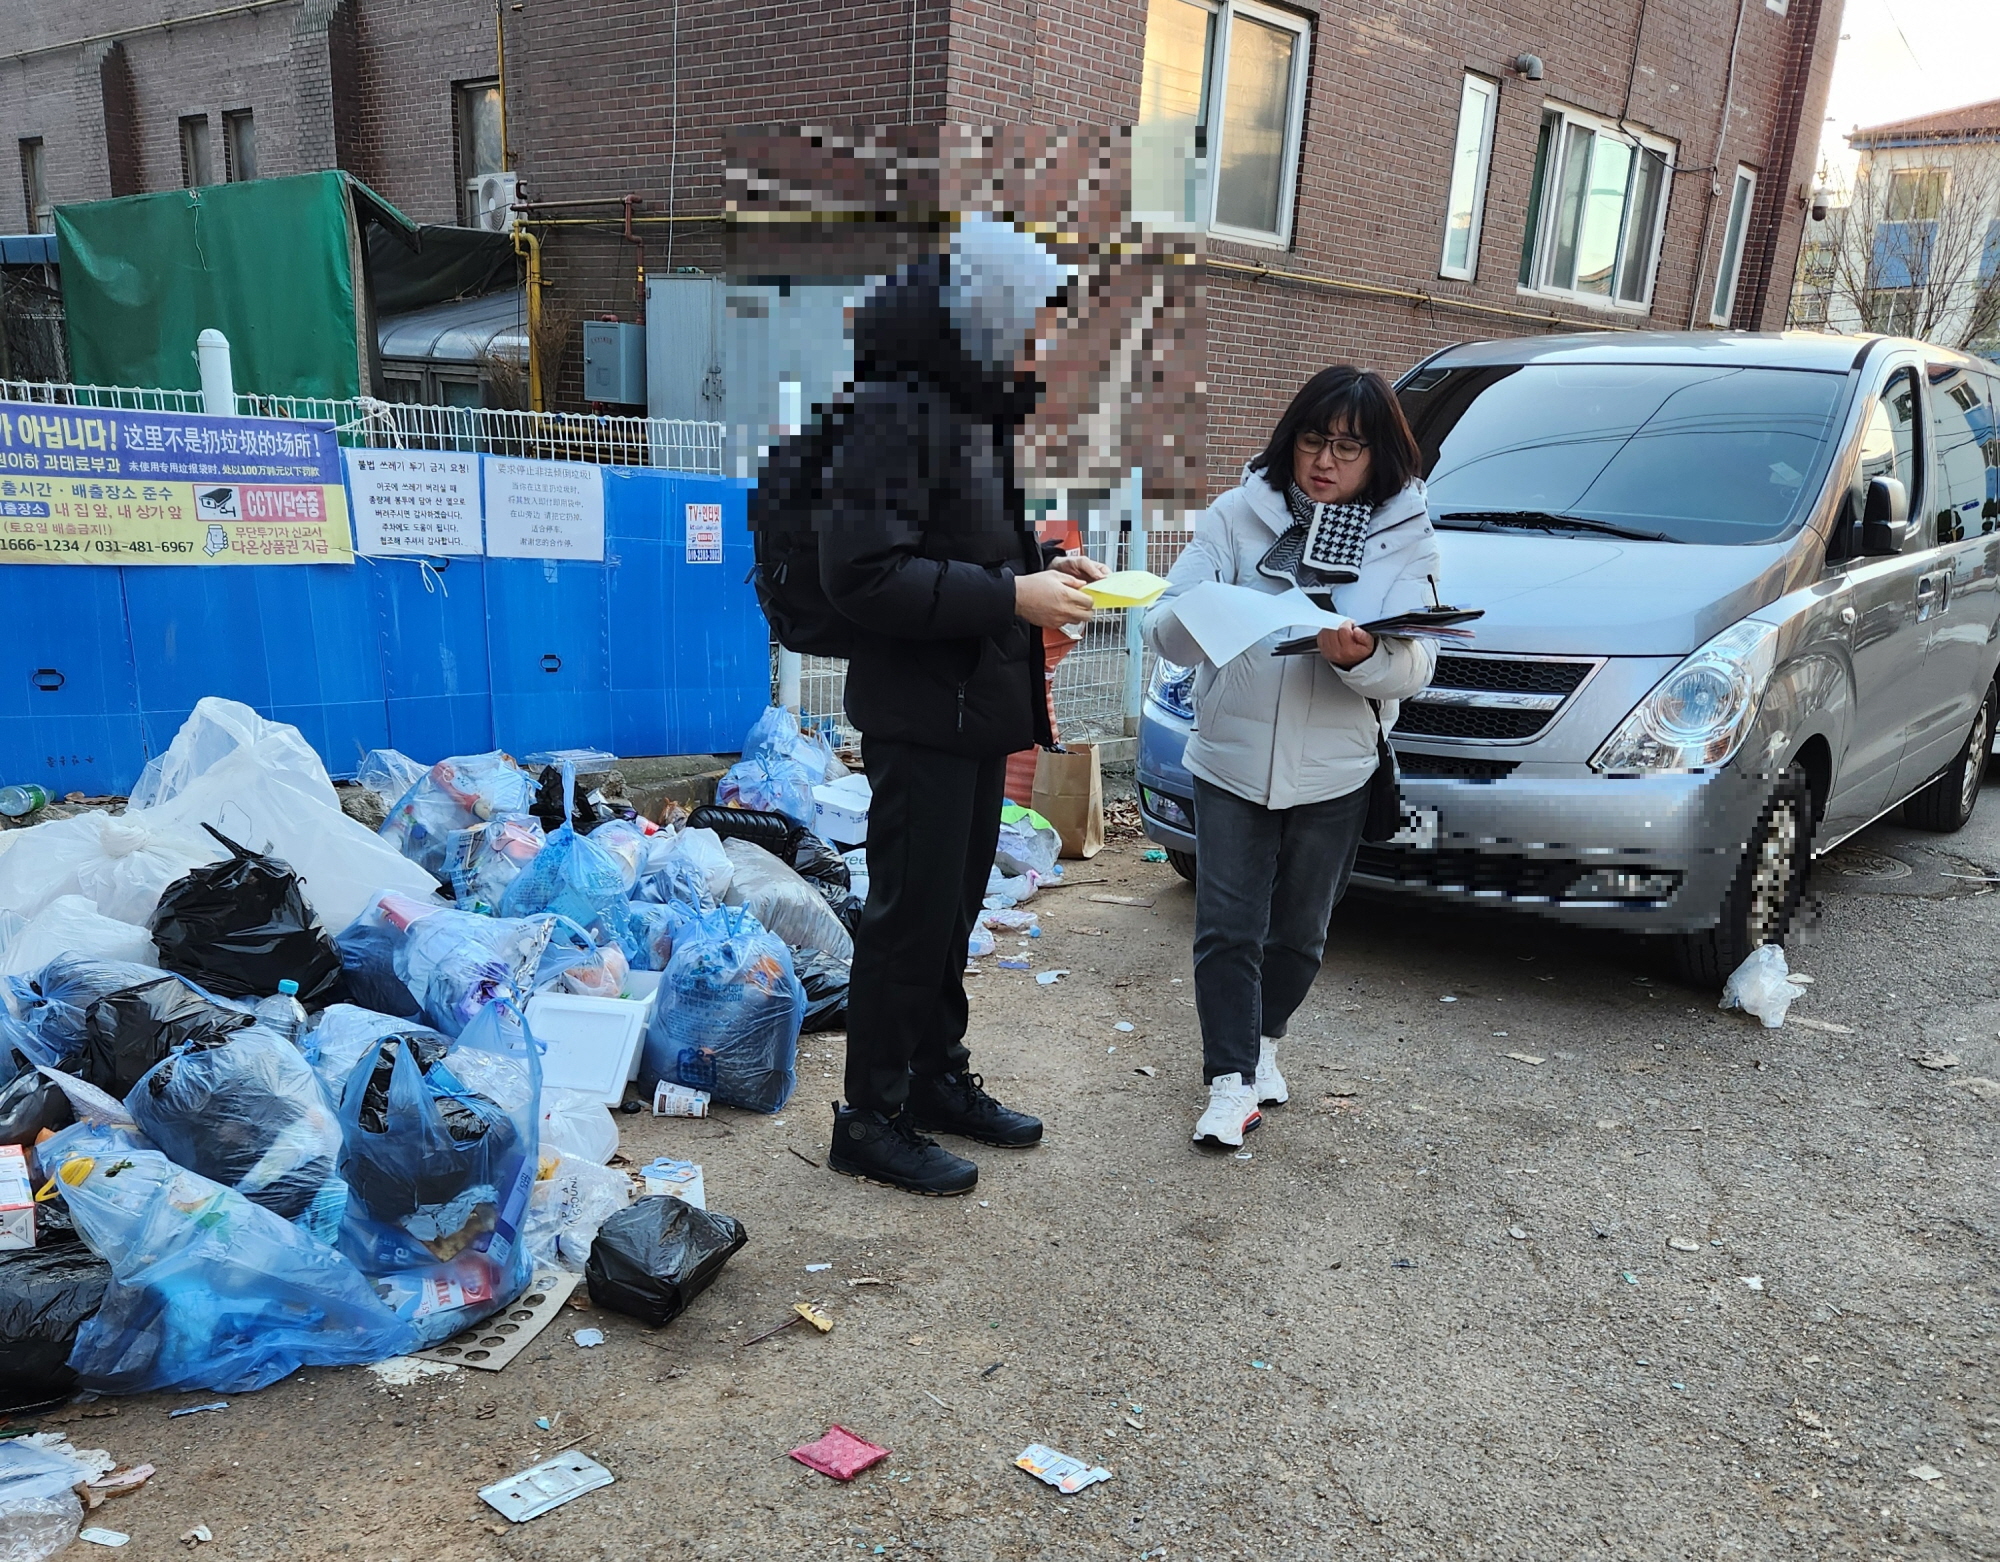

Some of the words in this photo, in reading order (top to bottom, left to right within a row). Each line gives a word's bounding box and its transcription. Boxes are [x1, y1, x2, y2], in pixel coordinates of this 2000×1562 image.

[18, 414, 117, 451] 아닙니다!
[123, 423, 321, 458] 这里不是扔垃圾的场所!
[43, 455, 121, 474] 과태료부과
[358, 459, 375, 471] 불법
[379, 461, 405, 472] 쓰레기
[408, 461, 426, 472] 투기
[429, 462, 446, 473] 금지
[449, 463, 469, 474] 요청!
[1, 481, 52, 497] 출시간
[71, 483, 138, 500] 배출장소
[142, 486, 173, 501] 준수
[376, 482, 399, 492] 이곳에
[401, 482, 423, 493] 쓰레기
[449, 484, 457, 493] 때
[0, 501, 45, 516] 출장소
[54, 503, 70, 517] 내
[74, 503, 89, 518] 집
[93, 503, 113, 519] 앞,
[117, 504, 132, 519] 내
[136, 504, 164, 520] 상가
[167, 505, 182, 520] 앞
[246, 490, 320, 518] CCTV단속중
[3, 521, 48, 534] (토요일
[52, 523, 113, 536] 배출금지!)
[235, 526, 289, 539] 무단투기자
[291, 526, 322, 539] 신고시
[1, 538, 80, 551] 1666-1234
[95, 541, 194, 553] 031-481-6967
[231, 539, 299, 555] 다온상품권
[302, 539, 329, 555] 지급
